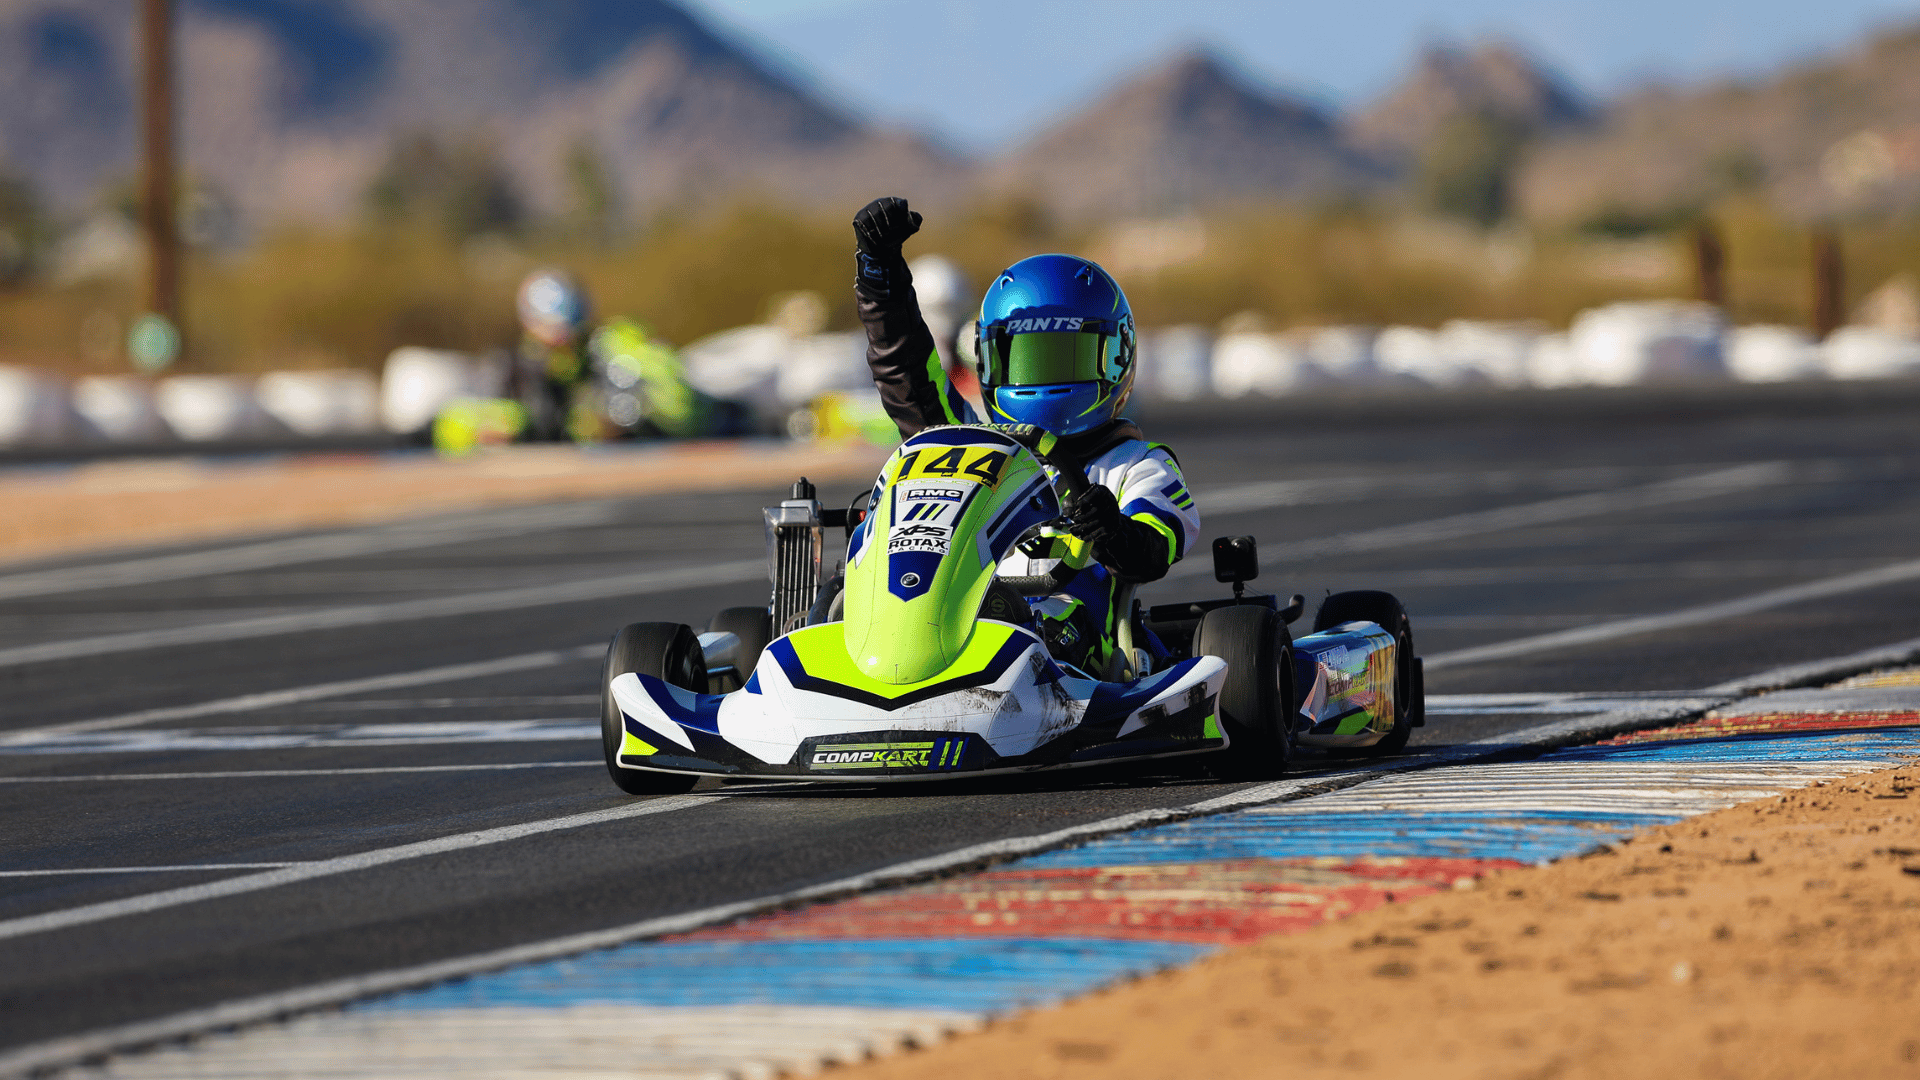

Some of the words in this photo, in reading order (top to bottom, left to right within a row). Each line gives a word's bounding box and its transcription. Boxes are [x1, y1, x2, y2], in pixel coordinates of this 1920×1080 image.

[1005, 317, 1084, 333] PANTS
[896, 448, 1009, 487] 144
[909, 489, 961, 499] RMC
[892, 524, 949, 538] XPS
[888, 538, 946, 550] ROTAX
[888, 546, 946, 554] RACING
[812, 750, 932, 766] COMPKART
